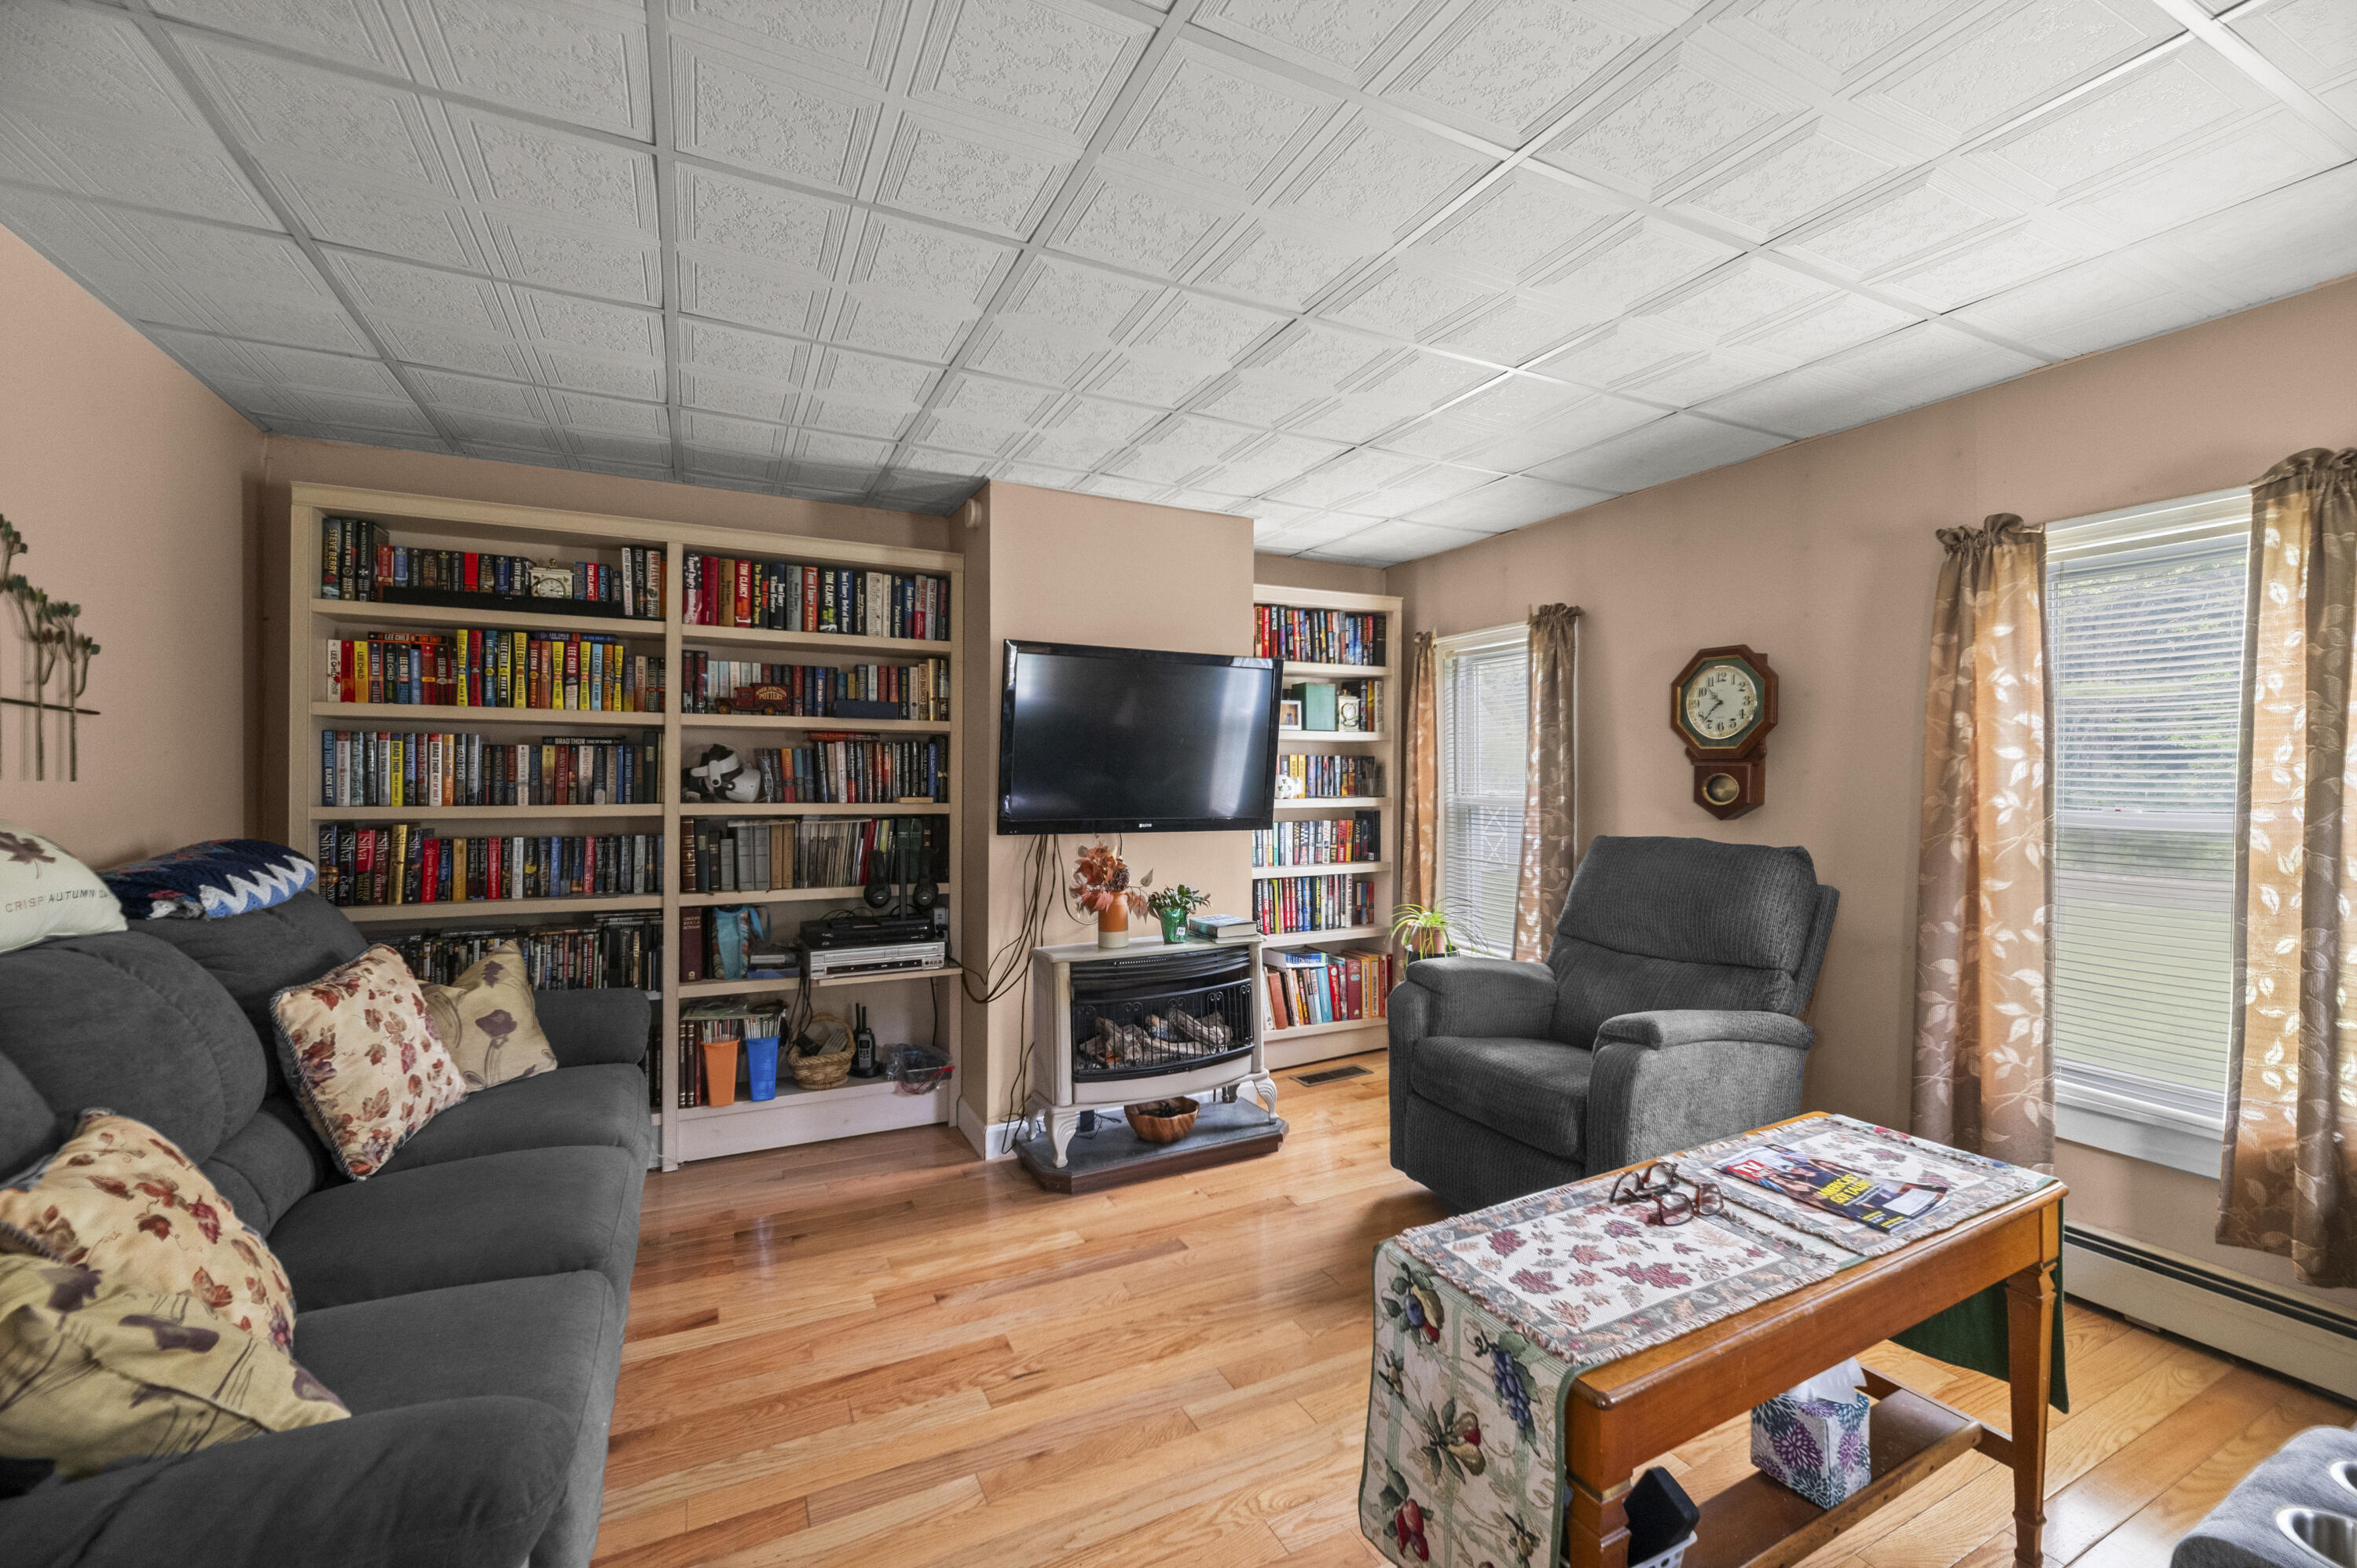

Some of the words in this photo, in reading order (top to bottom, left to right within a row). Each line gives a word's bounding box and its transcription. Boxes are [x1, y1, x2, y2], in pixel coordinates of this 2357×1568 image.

[328, 529, 338, 551] STEVE
[328, 551, 338, 575] BERRY
[739, 563, 748, 575] TOM
[808, 572, 816, 584] Tom
[825, 572, 834, 584] TOM
[739, 577, 748, 599] CLANCY
[805, 586, 816, 605] Clancy
[825, 584, 834, 607] CLANCY
[839, 583, 849, 598] Clancy
[567, 647, 577, 655] LEE
[567, 658, 577, 673] CHILD
[1706, 676, 1714, 687] 11
[1716, 672, 1727, 683] 12
[1730, 674, 1735, 685] 1
[1698, 687, 1707, 698] 10
[1739, 682, 1747, 691] 2
[759, 691, 786, 700] POTTERY
[1743, 695, 1750, 706] 3
[1737, 709, 1745, 719] 4
[1706, 719, 1713, 730] 7
[1717, 722, 1725, 731] 6
[1728, 717, 1736, 728] 5
[324, 731, 333, 749] BRAD
[324, 750, 333, 767] THOR
[324, 768, 333, 785] BLACK
[324, 786, 333, 797] LIST
[321, 833, 336, 859] Silva
[340, 836, 354, 862] Silva
[357, 836, 371, 861] Silva
[376, 836, 390, 861] Silva
[408, 836, 420, 858] Silva
[5, 896, 44, 913] CRISP
[48, 888, 95, 903] AUTUMN
[1732, 1161, 1764, 1174] TV
[1816, 1172, 1859, 1199] AMERICA'S
[1829, 1189, 1849, 1204] GOT
